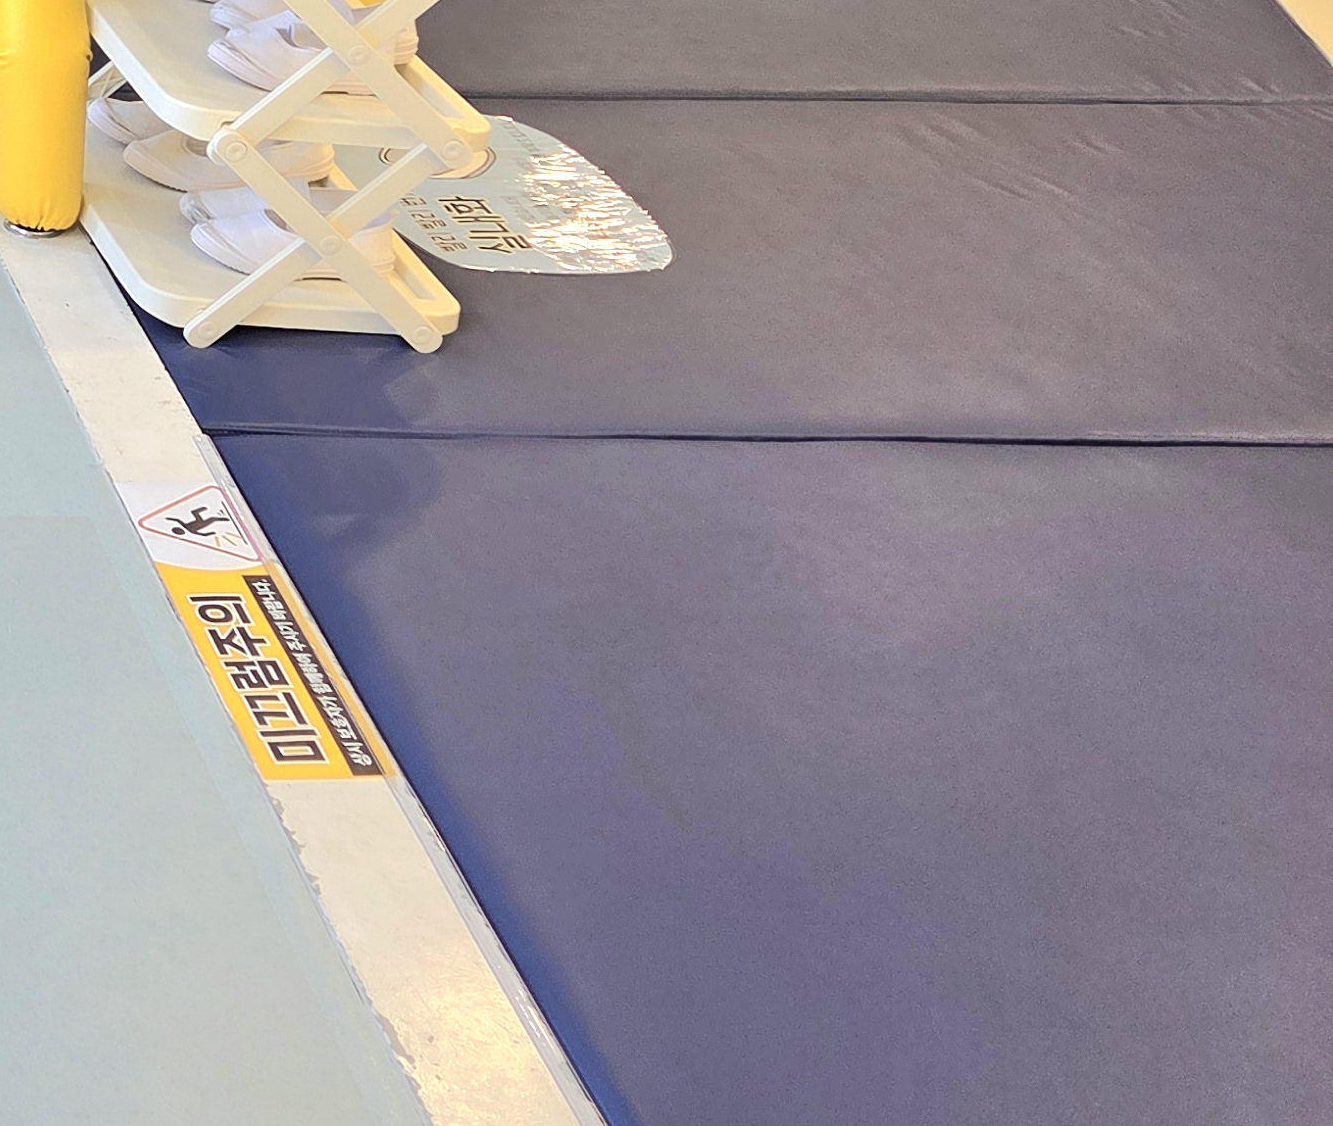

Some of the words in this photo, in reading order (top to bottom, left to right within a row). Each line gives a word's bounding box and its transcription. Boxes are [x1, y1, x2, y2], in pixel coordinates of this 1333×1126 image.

[437, 195, 534, 254] 실내화
[277, 621, 309, 651] 주시기
[186, 593, 331, 764] 미끄럼주의
[341, 742, 373, 765] 상시
